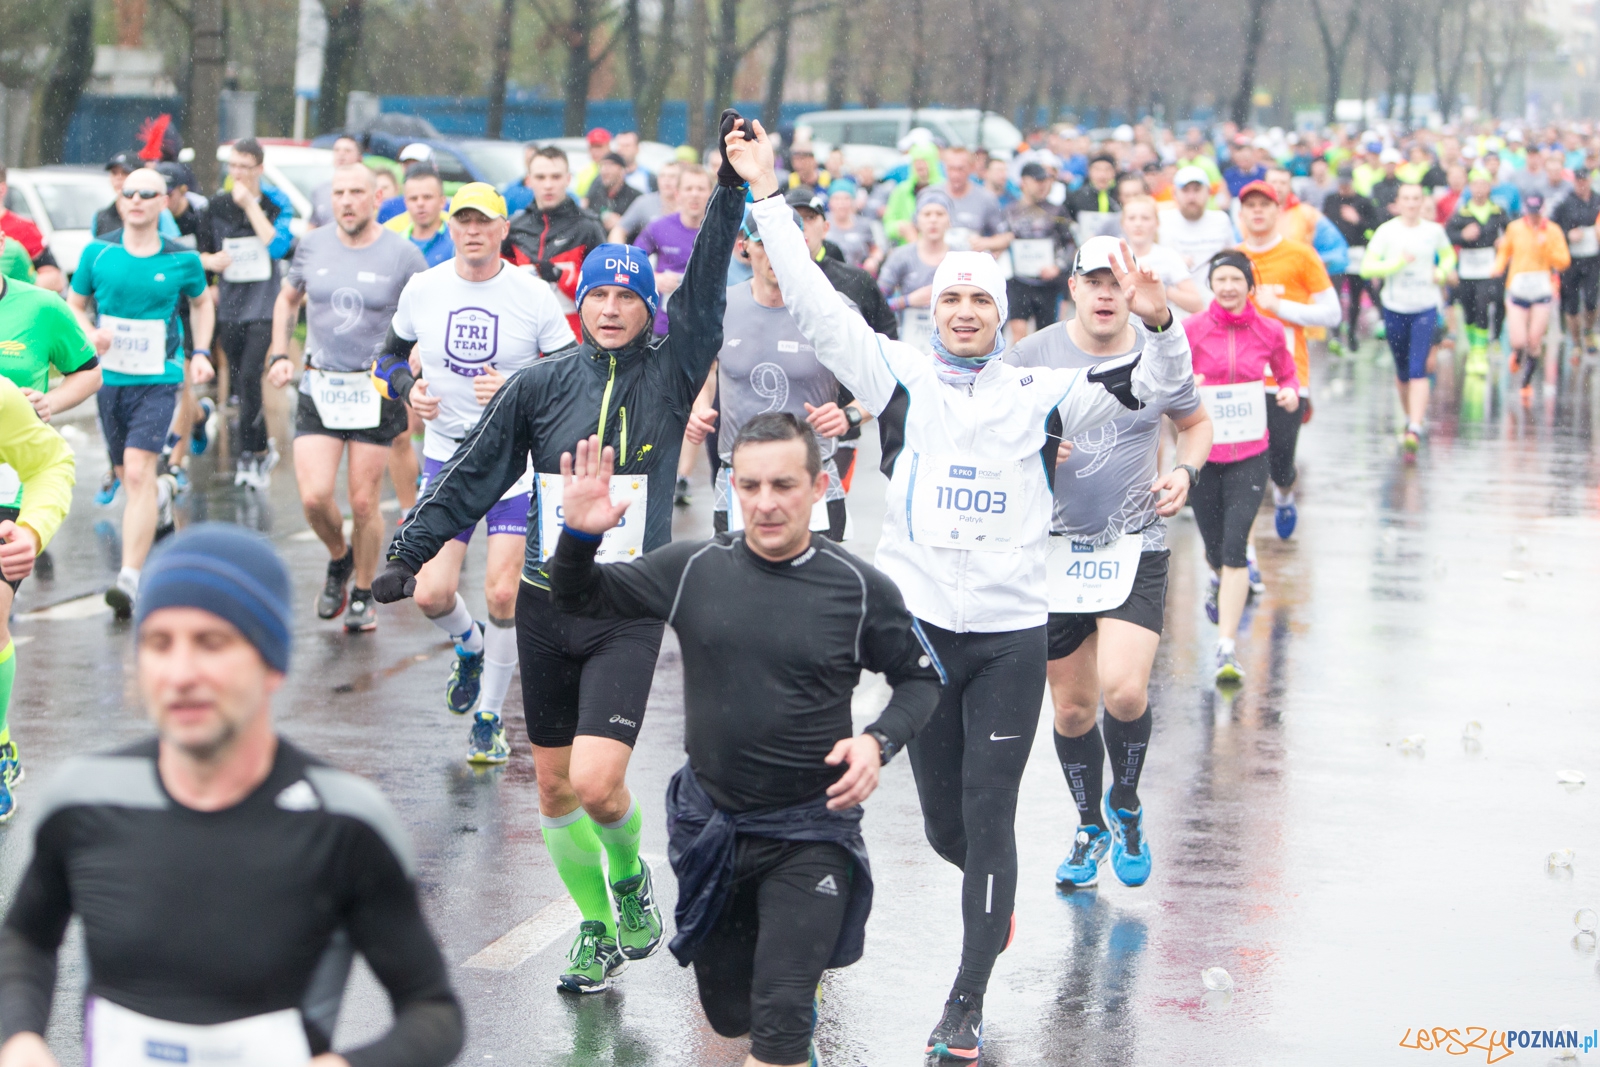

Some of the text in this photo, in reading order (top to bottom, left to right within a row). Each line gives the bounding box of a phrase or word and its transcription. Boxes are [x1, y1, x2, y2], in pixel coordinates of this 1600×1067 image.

[605, 254, 640, 274] DNB
[331, 286, 364, 335] 9
[455, 324, 488, 340] TRI
[454, 340, 487, 351] TEAM
[320, 389, 371, 405] 10946
[749, 361, 789, 416] 9
[1213, 402, 1253, 419] 3861
[936, 485, 1007, 514] 11003
[959, 514, 984, 524] Patryk
[1066, 560, 1120, 580] 4061
[619, 717, 637, 728] asics
[1120, 741, 1146, 787] Kalenji
